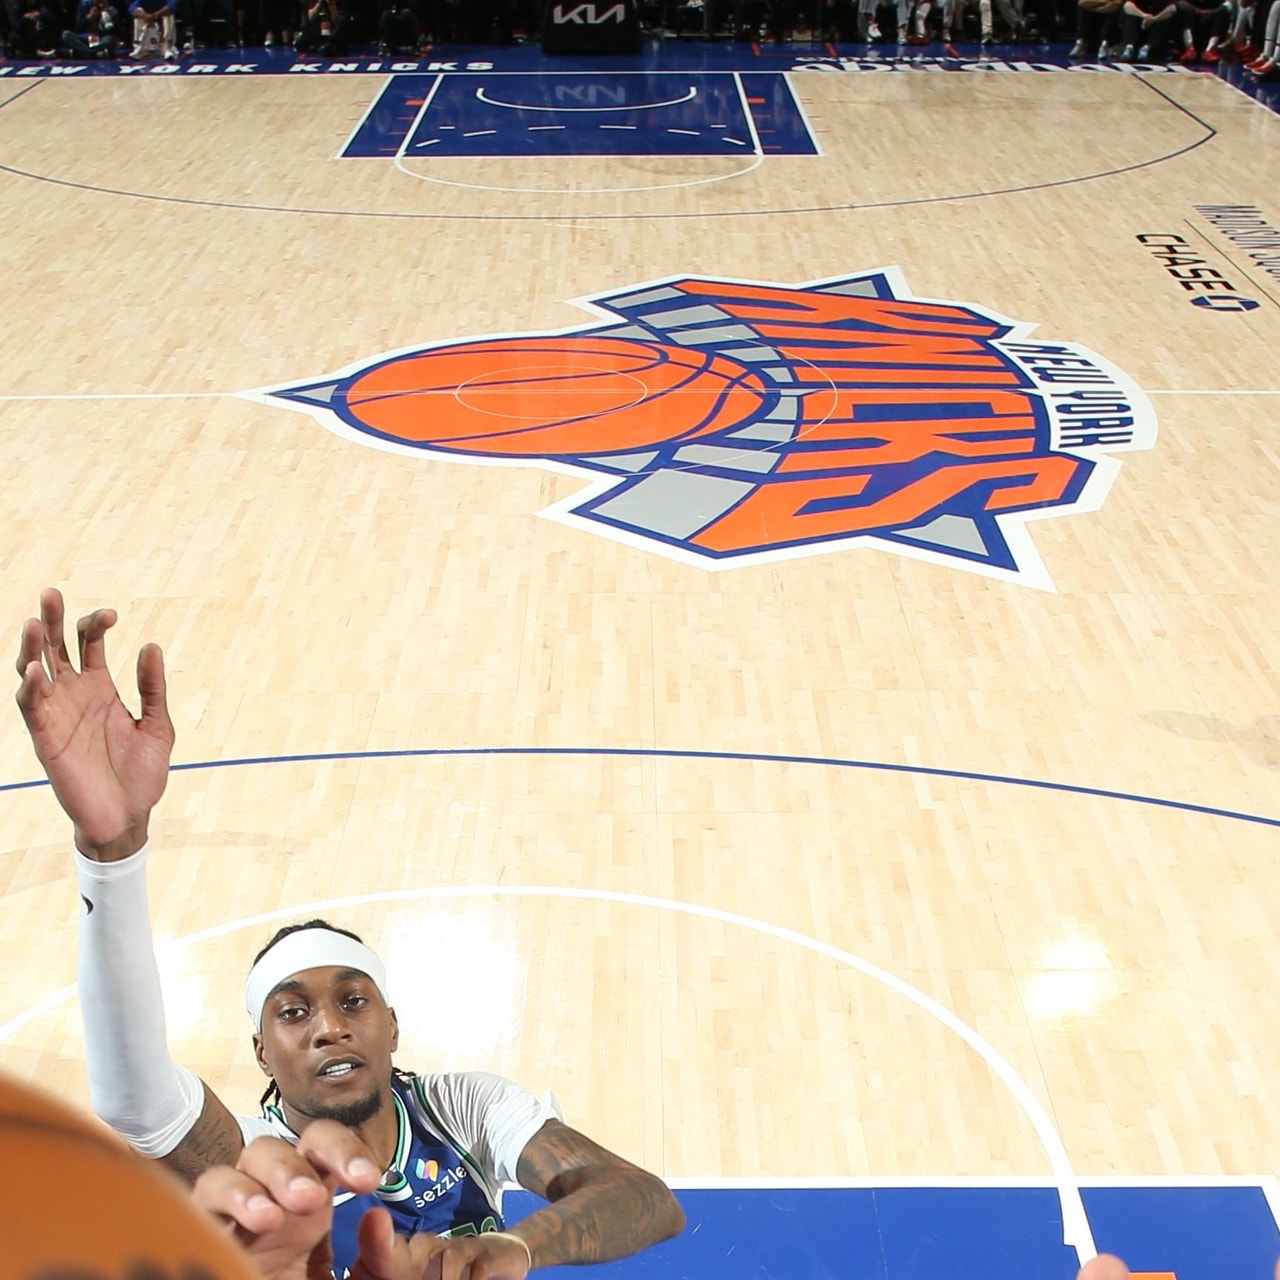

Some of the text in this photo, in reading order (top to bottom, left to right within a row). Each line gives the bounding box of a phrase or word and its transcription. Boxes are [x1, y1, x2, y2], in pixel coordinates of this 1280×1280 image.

[119, 64, 259, 74] YORK
[288, 62, 494, 72] KNICKS
[1135, 232, 1238, 292] CHASE
[673, 277, 1078, 554] KNICKS
[997, 342, 1135, 449] NEW YORK
[414, 1166, 467, 1208] sezzle
